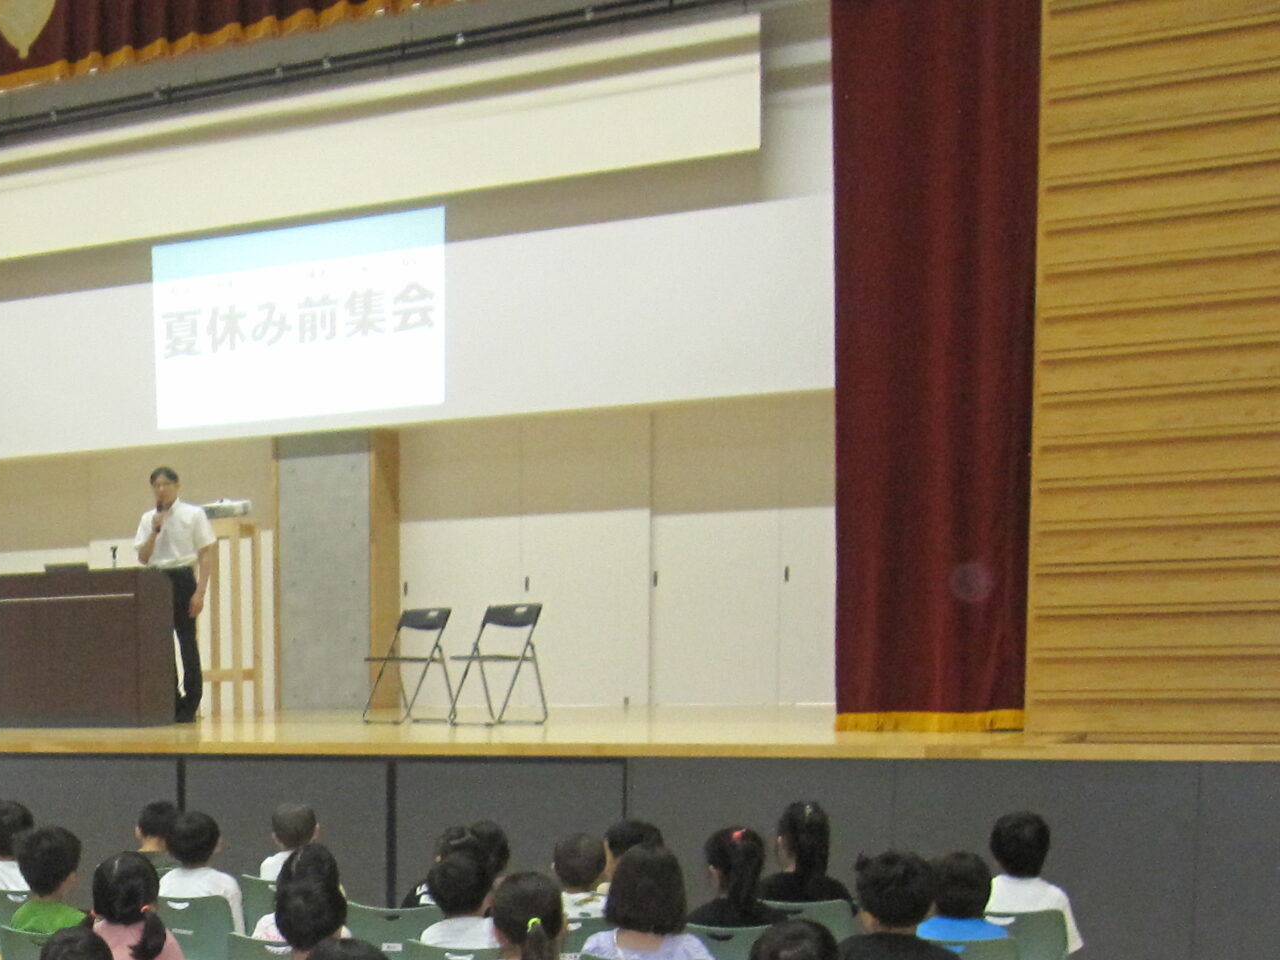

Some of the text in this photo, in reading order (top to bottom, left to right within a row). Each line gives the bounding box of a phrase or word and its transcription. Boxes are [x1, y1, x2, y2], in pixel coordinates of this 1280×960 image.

[161, 281, 435, 359] 夏休み前集会
